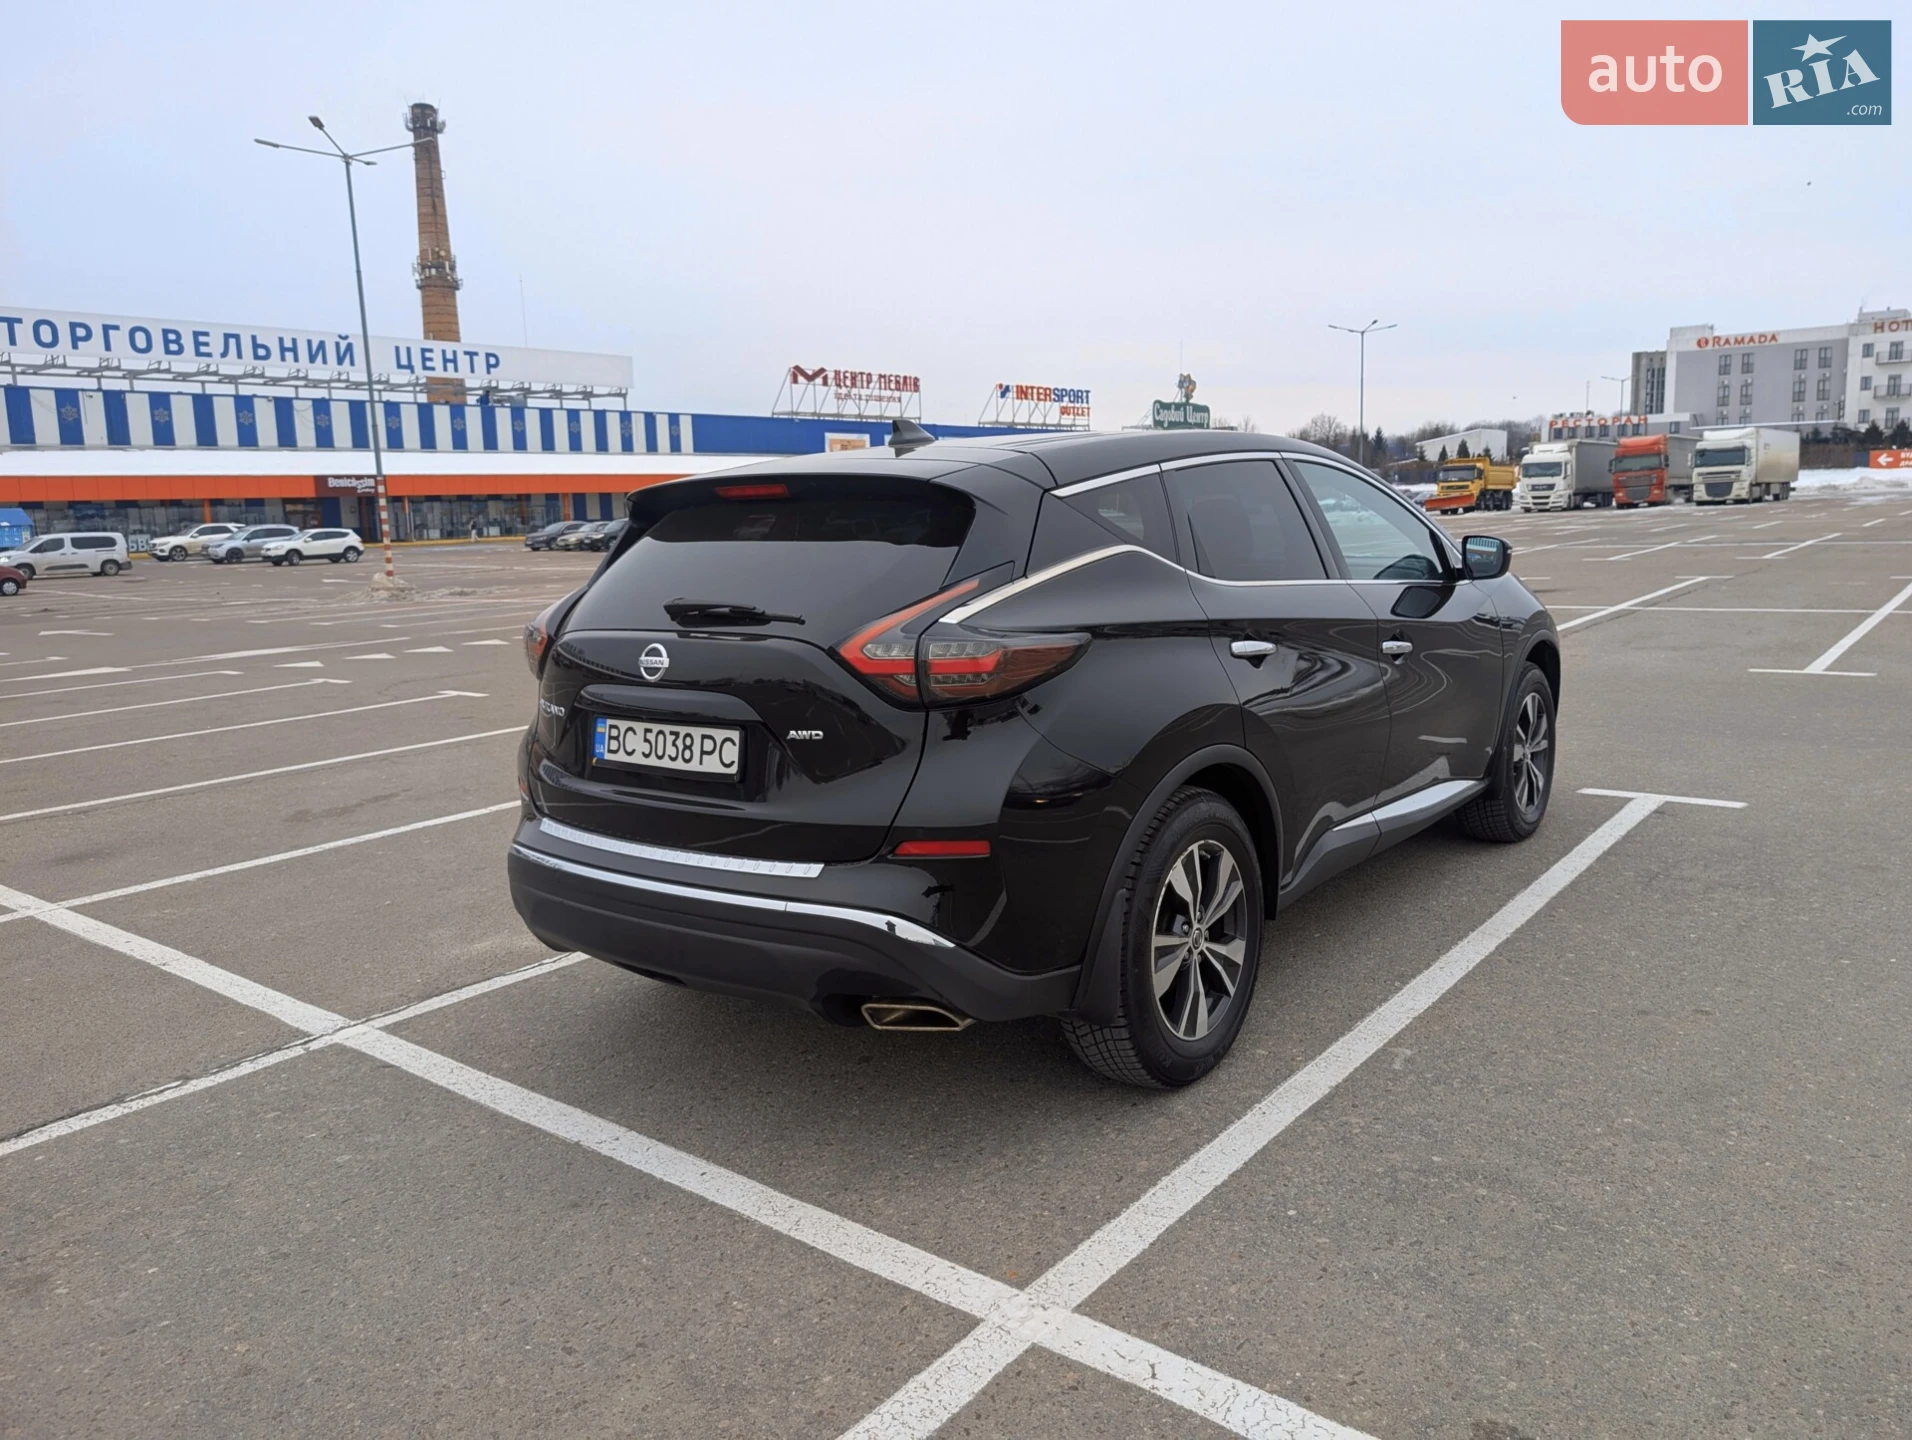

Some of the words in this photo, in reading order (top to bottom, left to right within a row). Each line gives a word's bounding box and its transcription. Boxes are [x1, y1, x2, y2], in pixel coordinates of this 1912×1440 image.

[0, 316, 356, 367] ТОРГОВЕЛЬНИЙ
[394, 345, 501, 375] ЦЕНТР
[834, 369, 873, 390] ЦЕНТР
[1015, 384, 1091, 405] INTERSPORT
[1059, 405, 1091, 417] OUTLET
[1186, 405, 1209, 428] Центр
[1549, 415, 1648, 429] РЕСТОРАН
[786, 730, 824, 740] AWD
